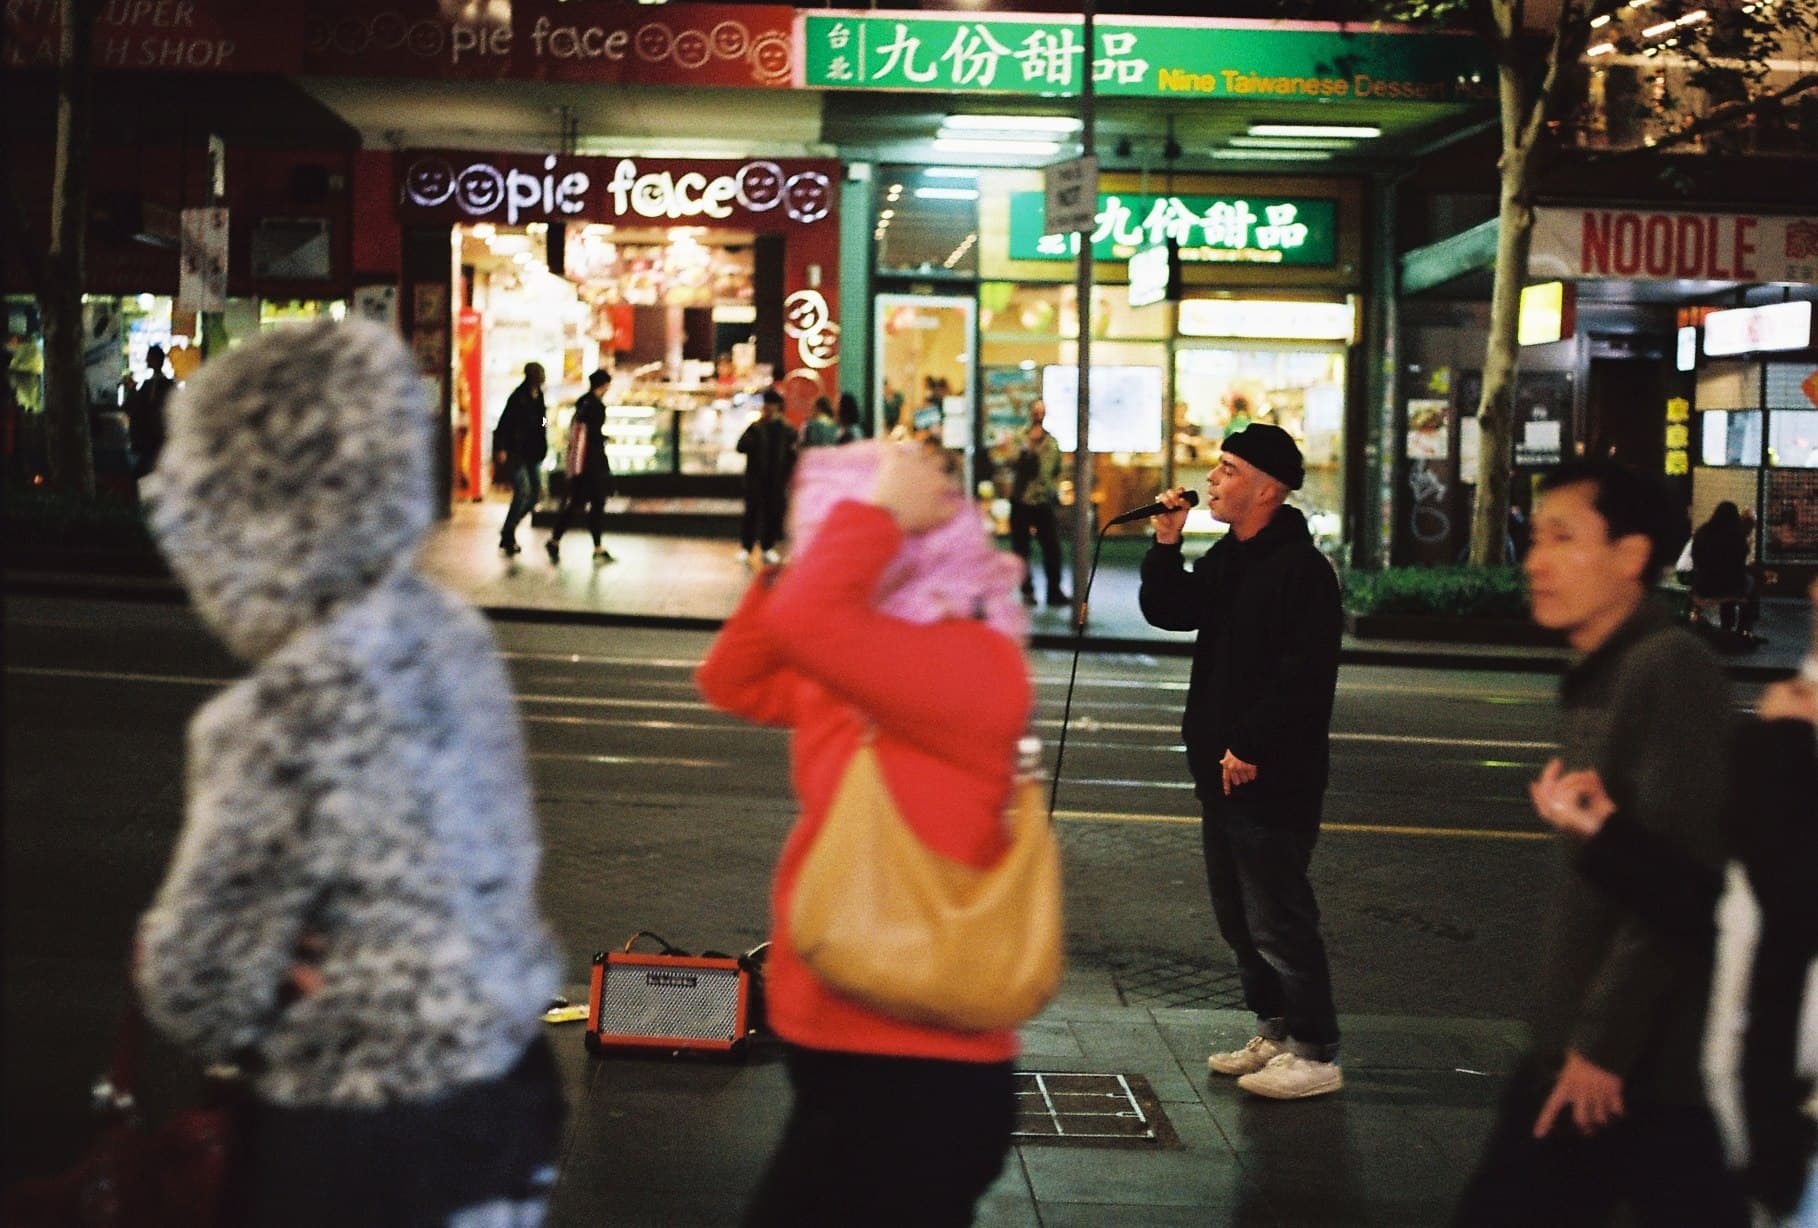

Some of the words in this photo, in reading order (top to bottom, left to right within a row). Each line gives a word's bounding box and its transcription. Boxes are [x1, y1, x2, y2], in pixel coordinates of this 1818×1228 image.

[96, 0, 195, 26] UPER
[451, 24, 513, 64] pie
[531, 16, 629, 60] face
[140, 40, 235, 66] SHOP
[826, 23, 854, 81] 台北
[872, 24, 1149, 86] 九份甜品
[1158, 68, 1216, 92] Nine
[1221, 69, 1349, 96] Taiwanese
[506, 155, 590, 225] pie
[607, 159, 738, 219] face
[1090, 196, 1308, 250] 九份甜品
[1580, 211, 1758, 280] NOODLE
